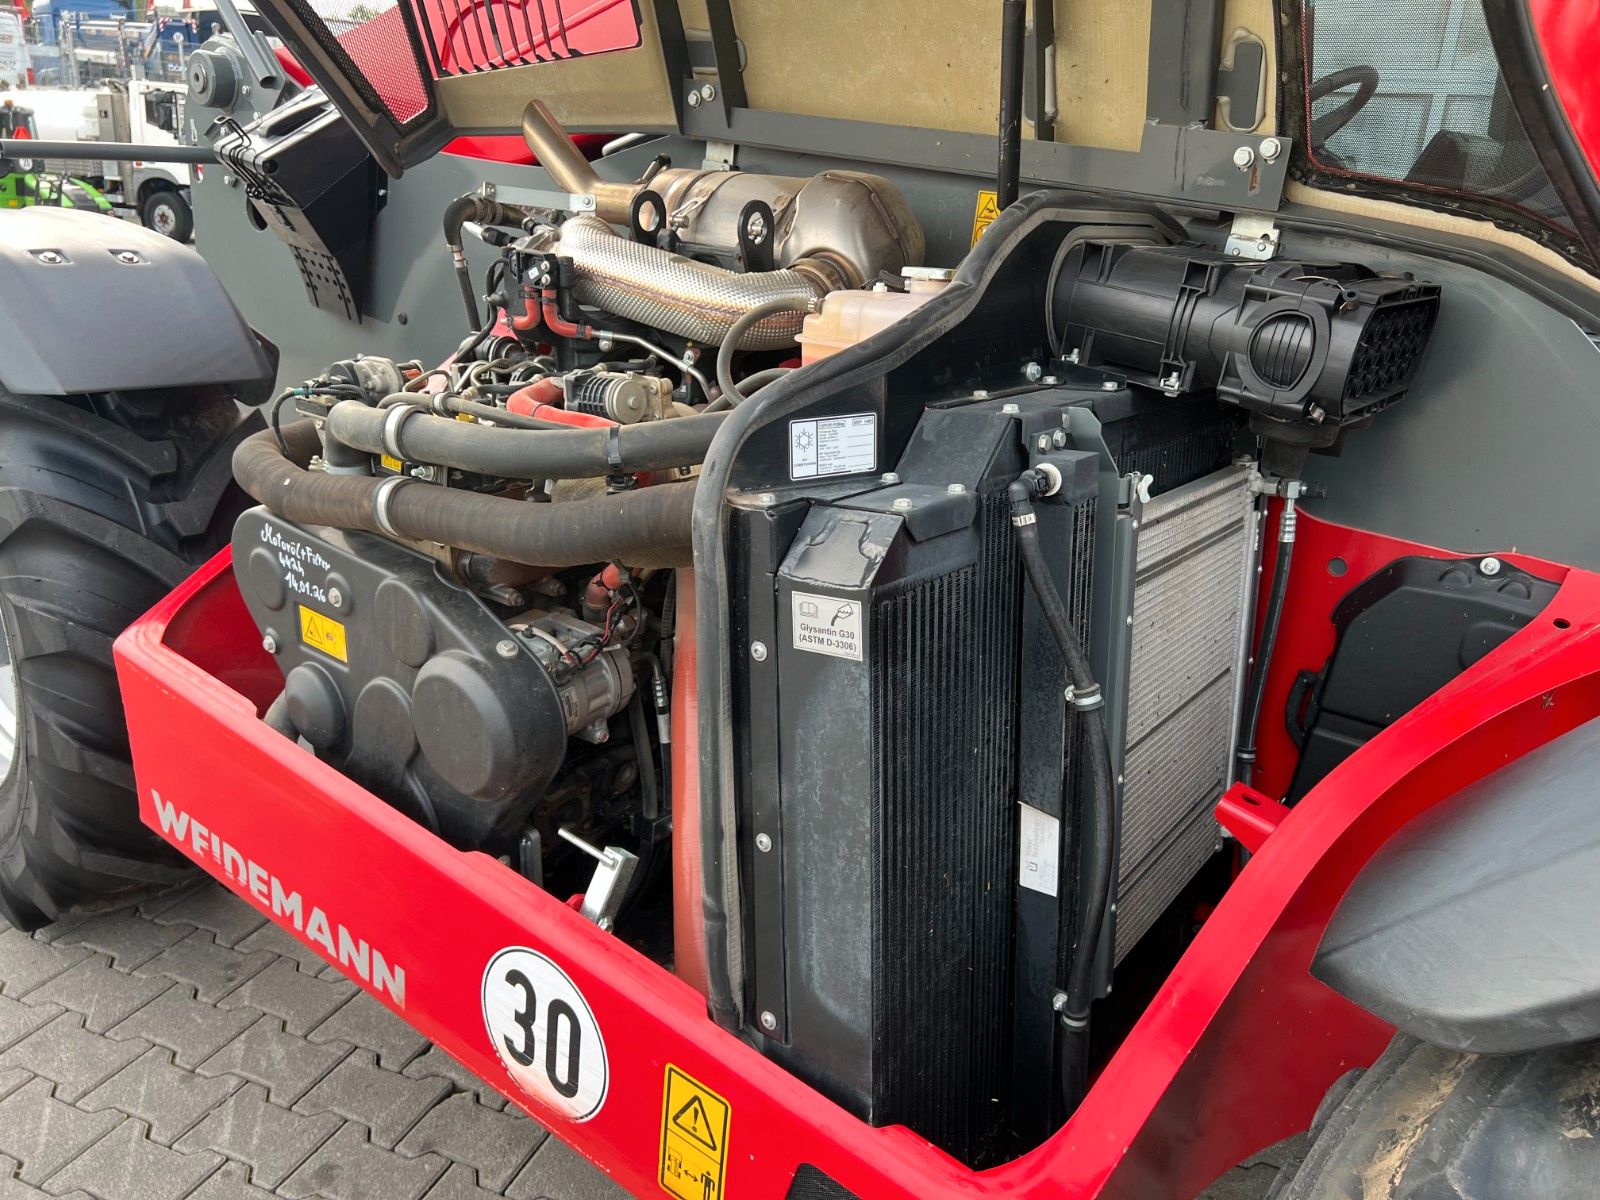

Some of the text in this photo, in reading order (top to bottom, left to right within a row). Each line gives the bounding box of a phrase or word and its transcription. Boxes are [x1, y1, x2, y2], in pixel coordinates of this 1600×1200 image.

[285, 571, 327, 603] 14.01.26
[799, 633, 857, 653] (ASTM D-3306)
[800, 623, 855, 640] Glysantin G30
[151, 788, 405, 1011] WEIDEMANN
[503, 969, 581, 1099] 30
